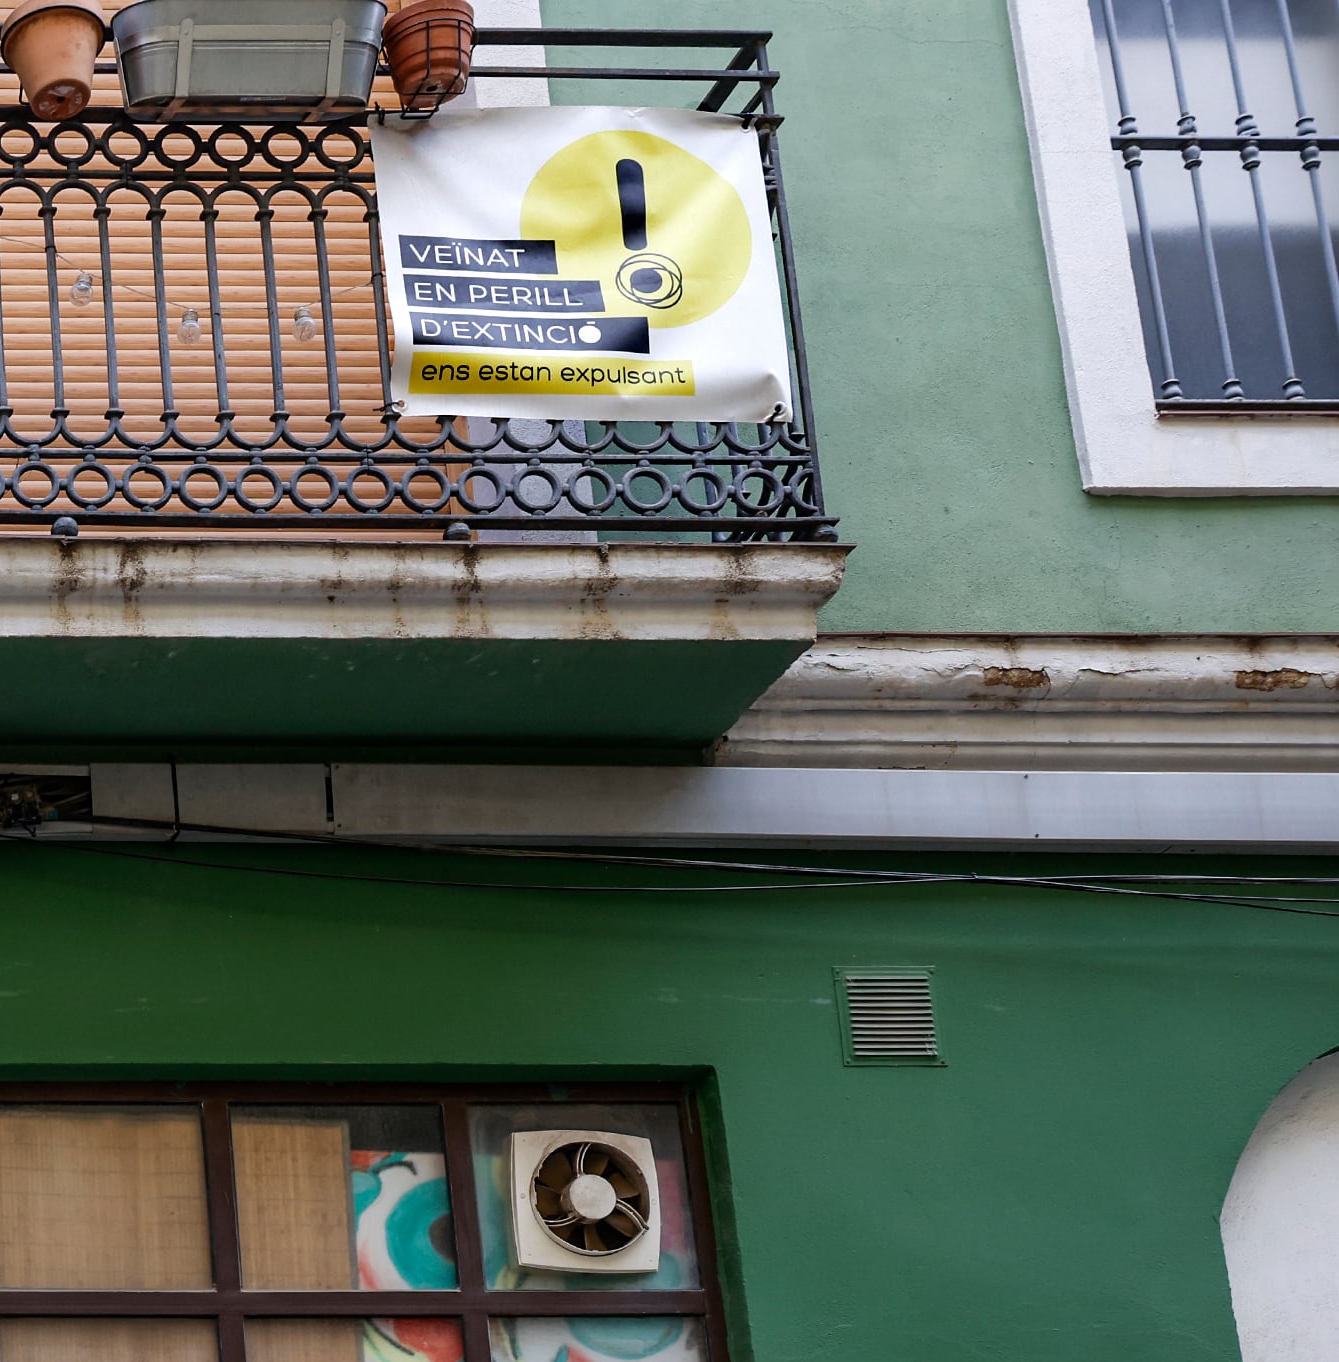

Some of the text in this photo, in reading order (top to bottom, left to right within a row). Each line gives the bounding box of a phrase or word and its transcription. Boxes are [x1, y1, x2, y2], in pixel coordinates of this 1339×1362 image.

[409, 241, 525, 268] VEÏNAT
[414, 282, 584, 307] EN PERILL
[421, 361, 687, 387] ens estan expulsant
